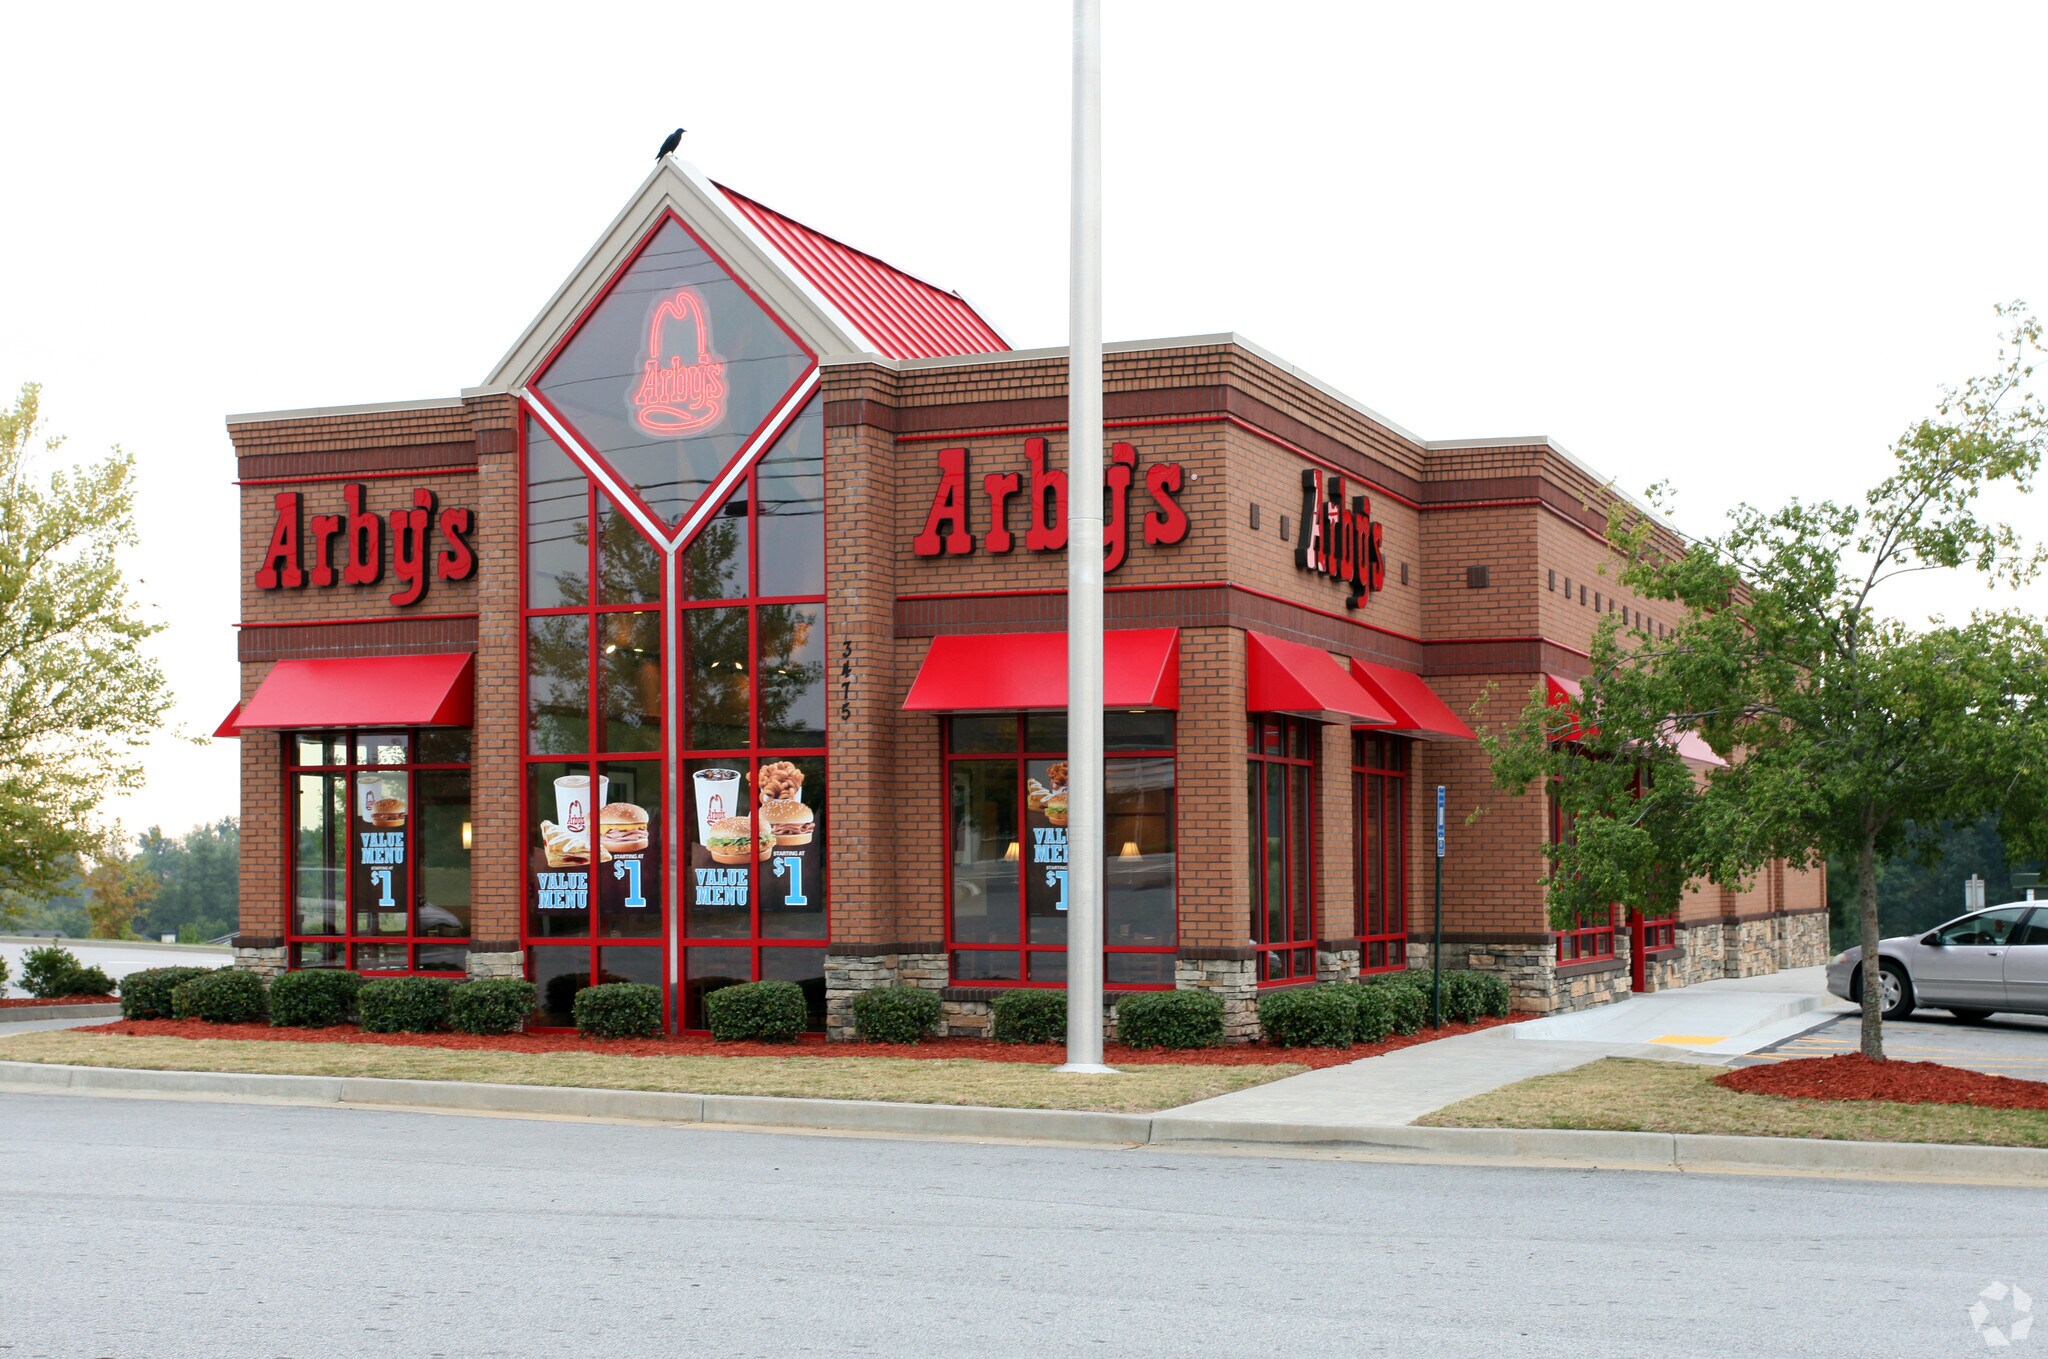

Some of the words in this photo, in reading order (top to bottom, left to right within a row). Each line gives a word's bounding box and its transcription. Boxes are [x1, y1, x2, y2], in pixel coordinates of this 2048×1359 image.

[635, 354, 723, 410] Arby's
[913, 437, 1190, 575] Arby's
[255, 484, 478, 606] Arby's
[841, 640, 853, 721] 3475
[360, 832, 405, 847] VALUE
[1033, 828, 1069, 844] VAL
[361, 847, 405, 864] MENU
[1034, 845, 1069, 863] ME
[537, 873, 588, 890] VALUE
[613, 859, 647, 908] $1
[695, 868, 748, 886] VALUE
[773, 856, 808, 906] $1
[370, 870, 396, 906] $1
[695, 885, 748, 906] MENU
[538, 890, 588, 909] MENU
